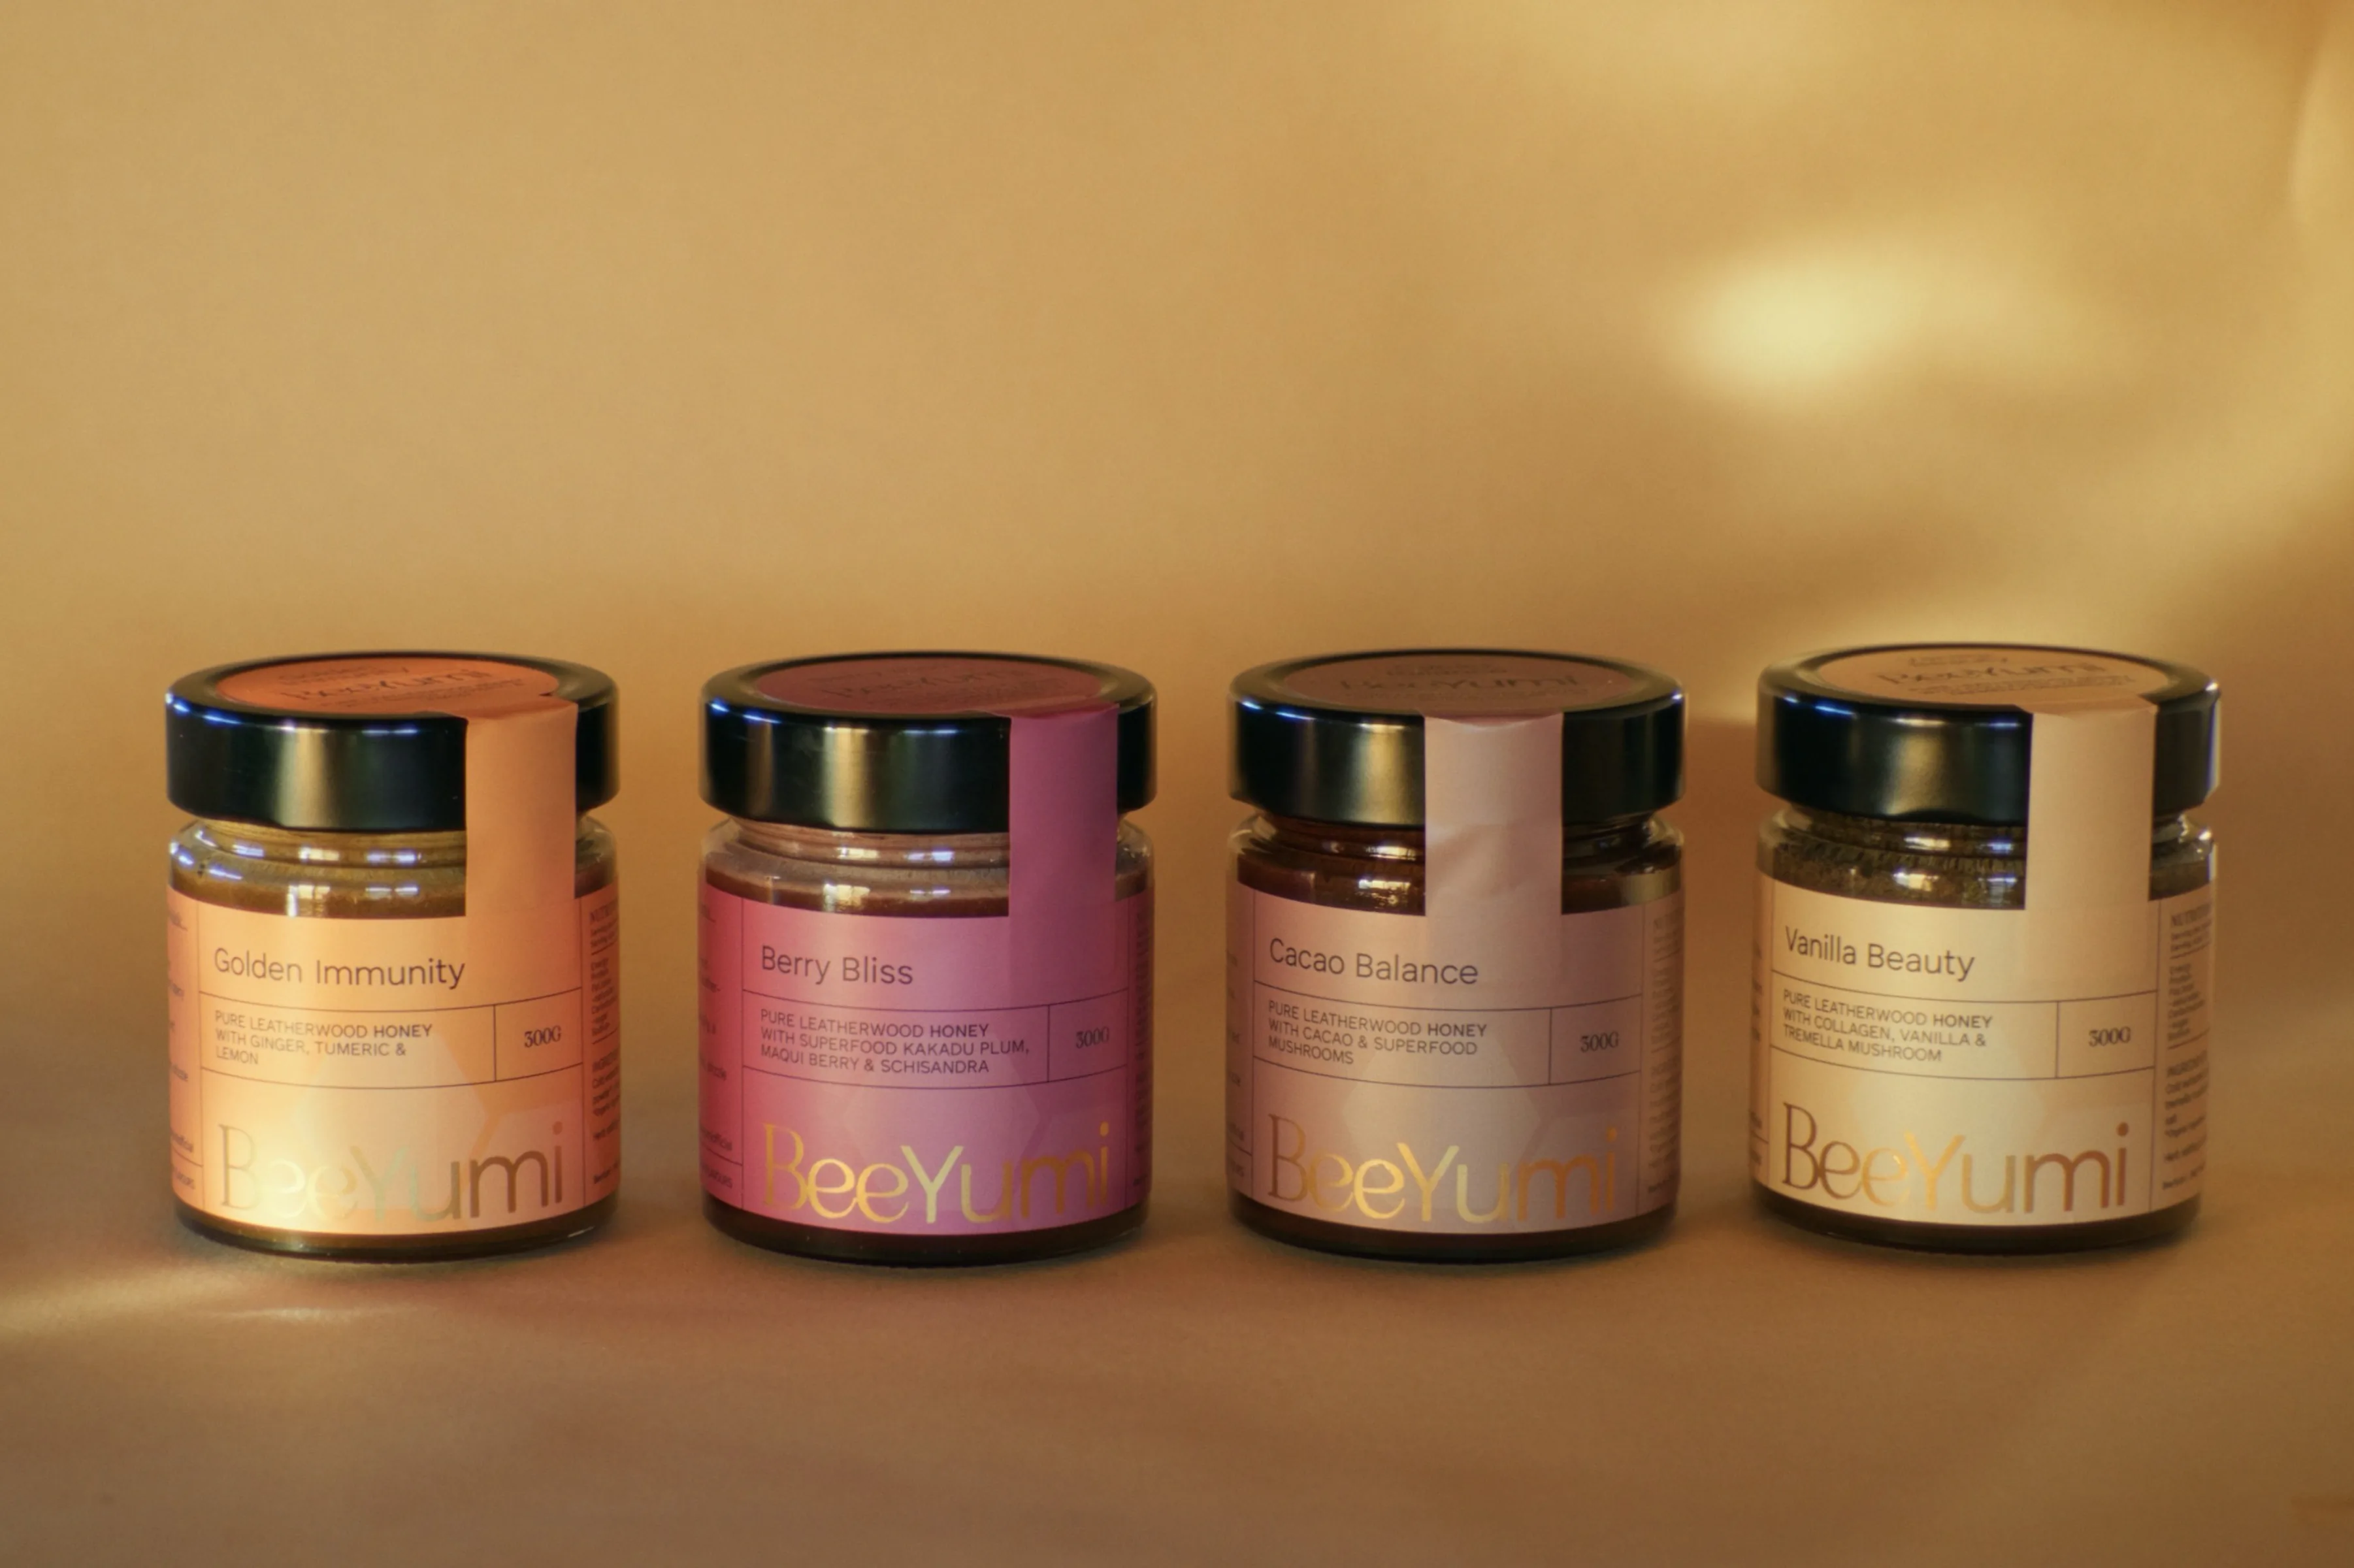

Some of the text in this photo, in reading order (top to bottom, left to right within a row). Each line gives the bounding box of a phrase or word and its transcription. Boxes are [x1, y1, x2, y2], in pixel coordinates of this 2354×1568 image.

[214, 947, 465, 990] Golden Immunity
[762, 945, 913, 985] Berry Bliss
[1269, 938, 1345, 975] Cacao
[1356, 953, 1479, 985] Balance
[1785, 925, 1975, 981] Vanilla Beauty
[216, 1009, 433, 1038] PURE LEATHERWOOD HONEY
[760, 1009, 989, 1037] PURE LEATHERWOOD HONEY
[1269, 1000, 1487, 1037] PURE LEATHERWOOD HONEY
[1784, 988, 1993, 1028] PURE LEATHERWOOD HONEY
[1784, 1007, 1986, 1046] WITH COLLAGEN, VANILLA &
[216, 1028, 406, 1056] WITH GINGER, TUMERIC &
[523, 1028, 561, 1048] 300G
[760, 1027, 1030, 1056] WITH SUPERFOOD KAKADU PLUM,
[1268, 1035, 1354, 1065] MUSHROOMS
[1269, 1017, 1477, 1055] WITH CACAO & SUPERFOOD
[1580, 1032, 1620, 1053] 300G
[1784, 1024, 1942, 1062] TREMELLA MUSHROOM
[216, 1047, 259, 1064] LEMON
[760, 1044, 989, 1074] MAQUI BERRY & SCHISANDRA
[218, 1121, 563, 1223] BeeYumi
[762, 1121, 1109, 1224] BeeYumi
[1267, 1114, 1617, 1224] BeeYumi
[1782, 1103, 2130, 1215] BeeYumi
